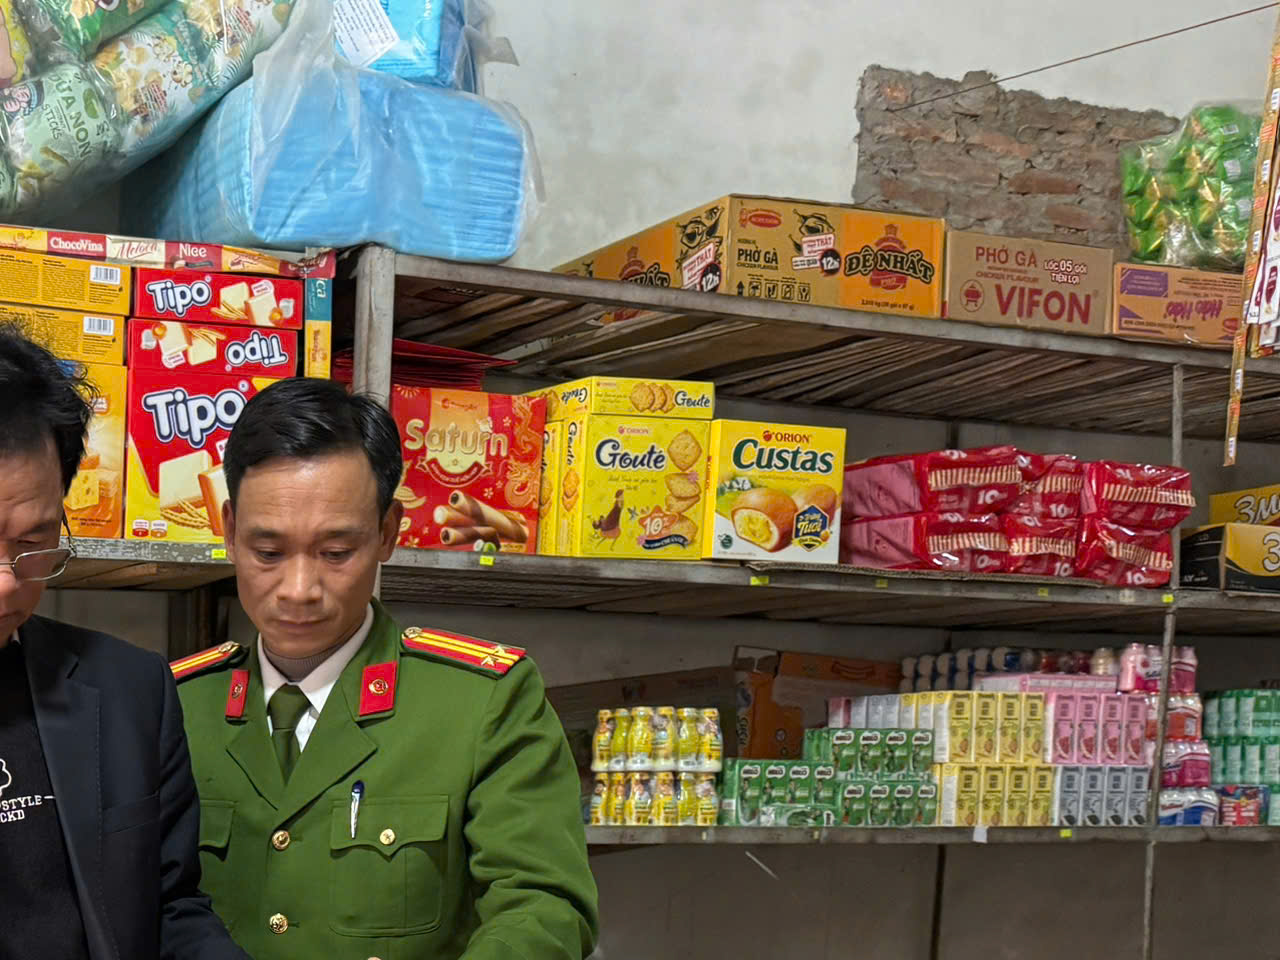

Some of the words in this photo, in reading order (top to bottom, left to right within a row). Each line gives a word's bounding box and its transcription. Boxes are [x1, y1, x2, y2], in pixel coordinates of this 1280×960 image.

[69, 112, 91, 159] NON
[975, 244, 1009, 265] PHỞ
[1059, 260, 1073, 272] 05
[148, 280, 212, 316] Tipo
[995, 284, 1092, 325] VIFON
[227, 331, 289, 367] Tipo
[674, 390, 711, 408] Gouté
[142, 388, 248, 449] Tipo
[404, 418, 509, 457] Saturn
[595, 439, 667, 470] Gouté
[775, 432, 810, 444] ORION
[733, 438, 834, 474] Custas
